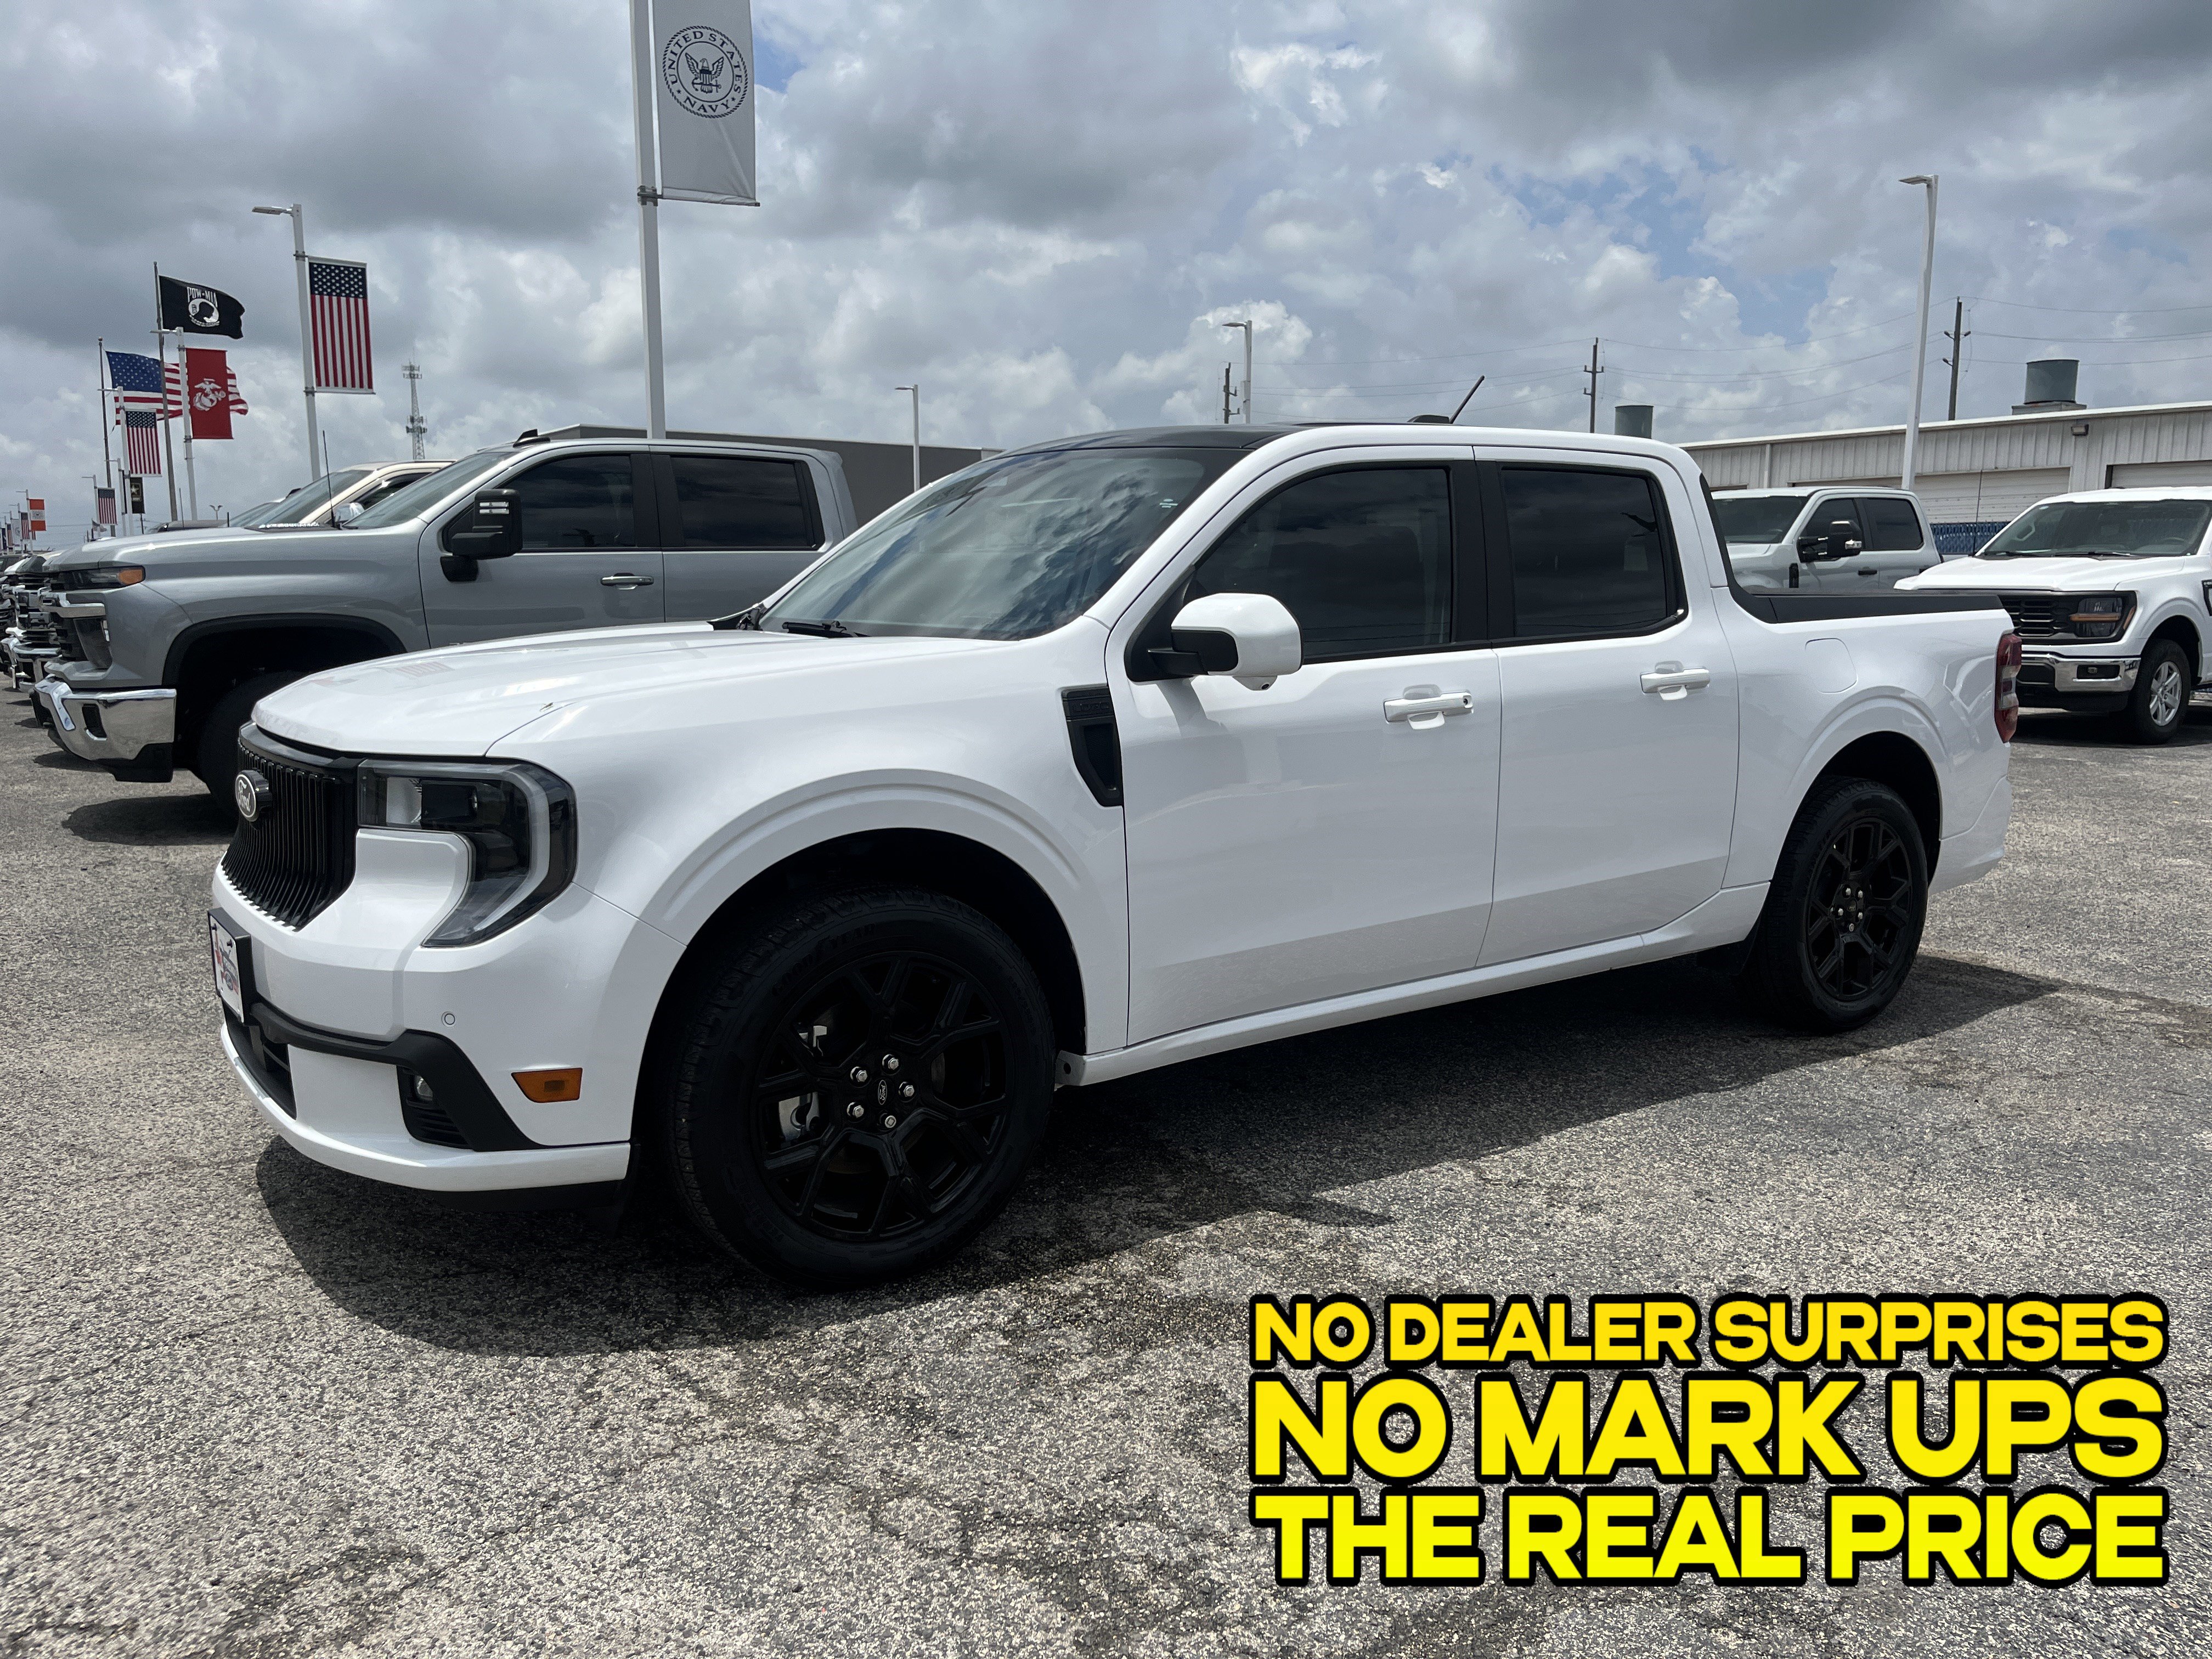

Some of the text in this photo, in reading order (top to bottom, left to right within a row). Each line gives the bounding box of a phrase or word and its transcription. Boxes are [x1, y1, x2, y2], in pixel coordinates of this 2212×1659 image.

[668, 31, 743, 94] UNITED STATES
[684, 95, 730, 113] NAVY
[187, 286, 218, 308] POW MIA
[238, 779, 251, 812] Ford
